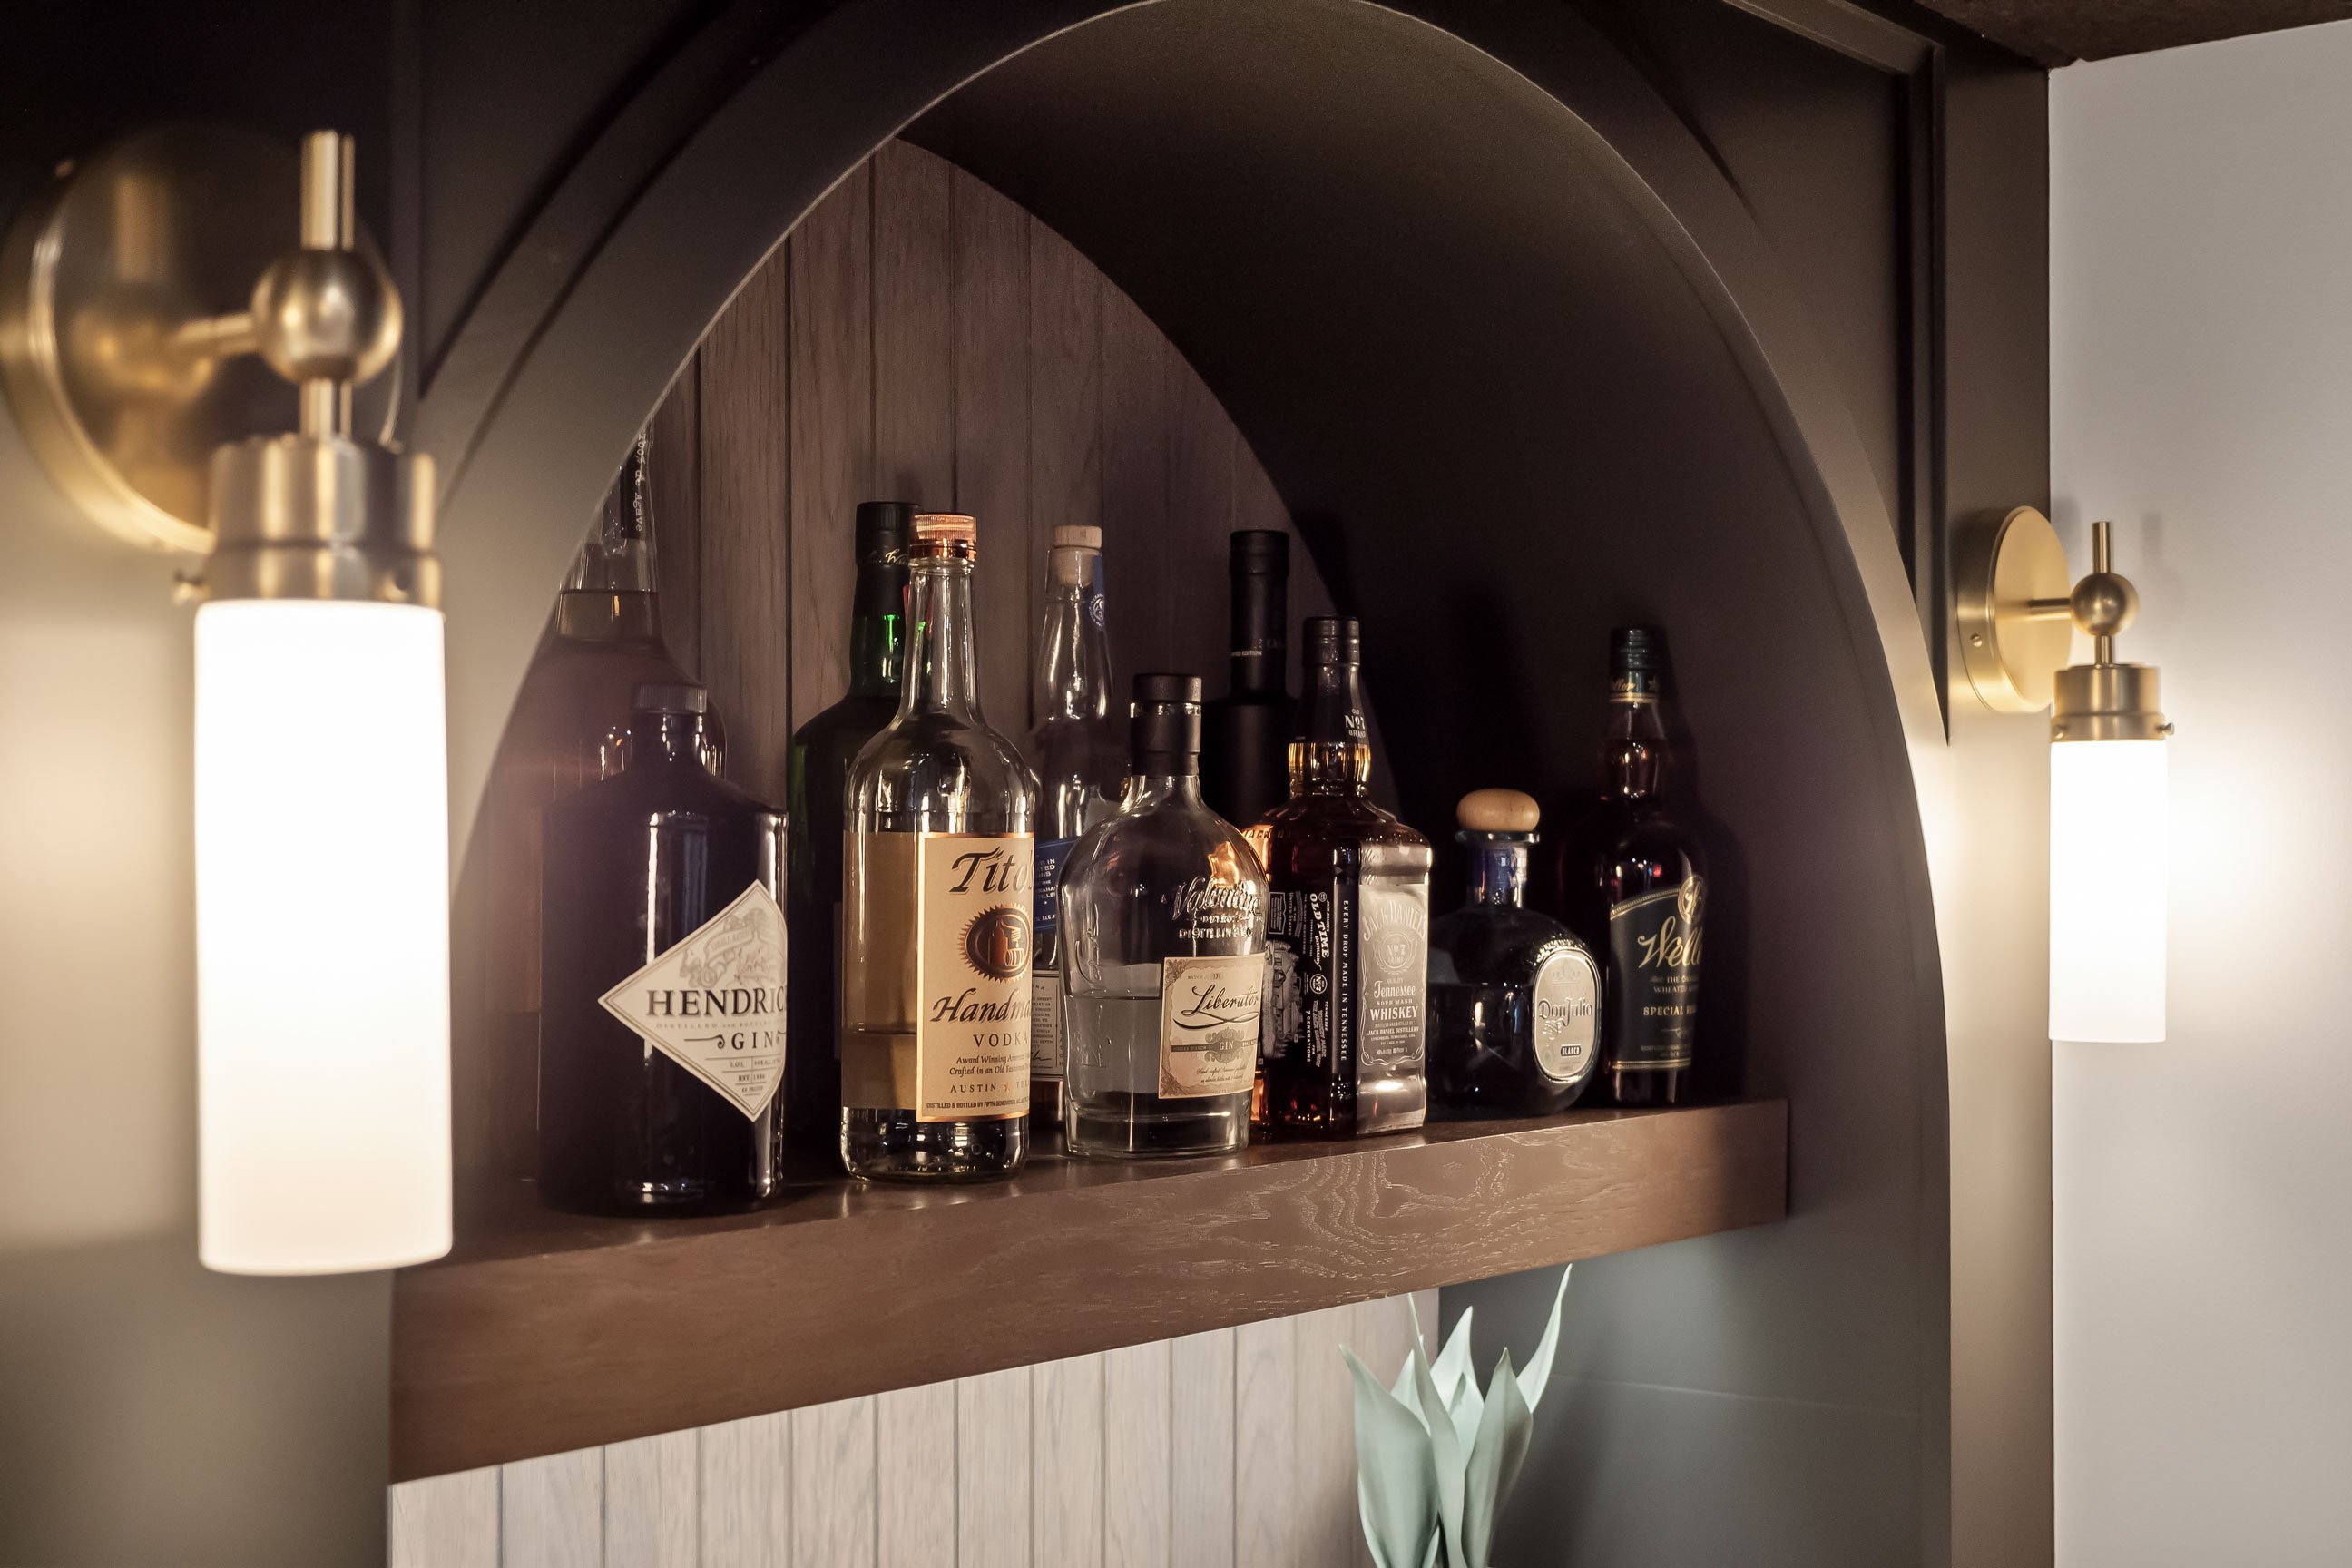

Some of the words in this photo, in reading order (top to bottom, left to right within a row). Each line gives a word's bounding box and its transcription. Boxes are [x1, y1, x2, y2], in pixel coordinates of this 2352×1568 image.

[632, 492, 642, 532] Agave
[949, 847, 1034, 894] Tito'
[1309, 893, 1322, 920] OLD
[1317, 921, 1329, 958] TIME
[1374, 980, 1416, 998] Tennessee
[646, 986, 786, 1017] HENDRIC
[1342, 993, 1348, 1003] IN
[1369, 1006, 1418, 1021] WHISKEY
[1643, 1005, 1684, 1015] SPECIAL
[731, 1032, 773, 1050] GIN
[973, 1033, 1028, 1047] VODKA
[1220, 1041, 1234, 1050] GIN
[956, 1054, 979, 1064] Award
[981, 1053, 1007, 1066] Winning
[949, 1066, 975, 1077] Crafted
[995, 1065, 1005, 1073] Old
[950, 1083, 996, 1093] AUSTIN
